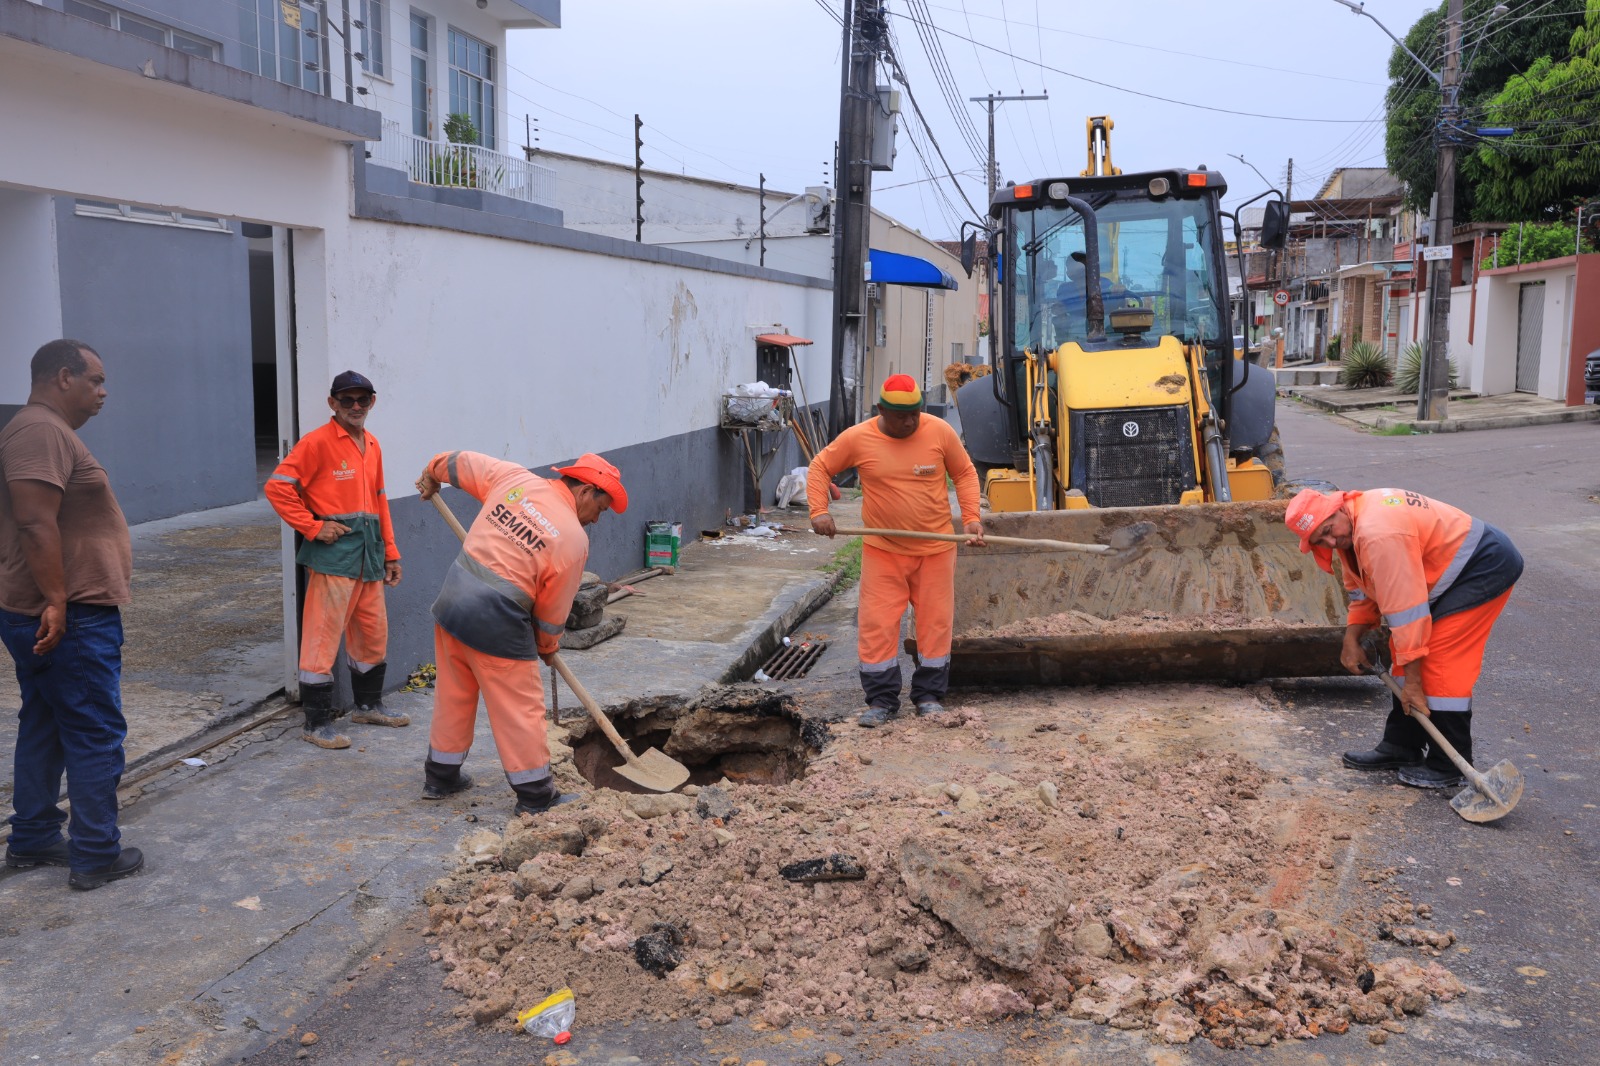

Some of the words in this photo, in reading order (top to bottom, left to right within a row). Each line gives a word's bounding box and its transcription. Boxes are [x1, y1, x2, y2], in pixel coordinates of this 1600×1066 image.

[485, 514, 509, 536] Secretaria
[507, 533, 516, 543] de
[515, 540, 534, 557] Obras
[491, 503, 546, 552] SEMINF
[518, 497, 560, 538] Manaus
[519, 510, 544, 535] Prefeitura
